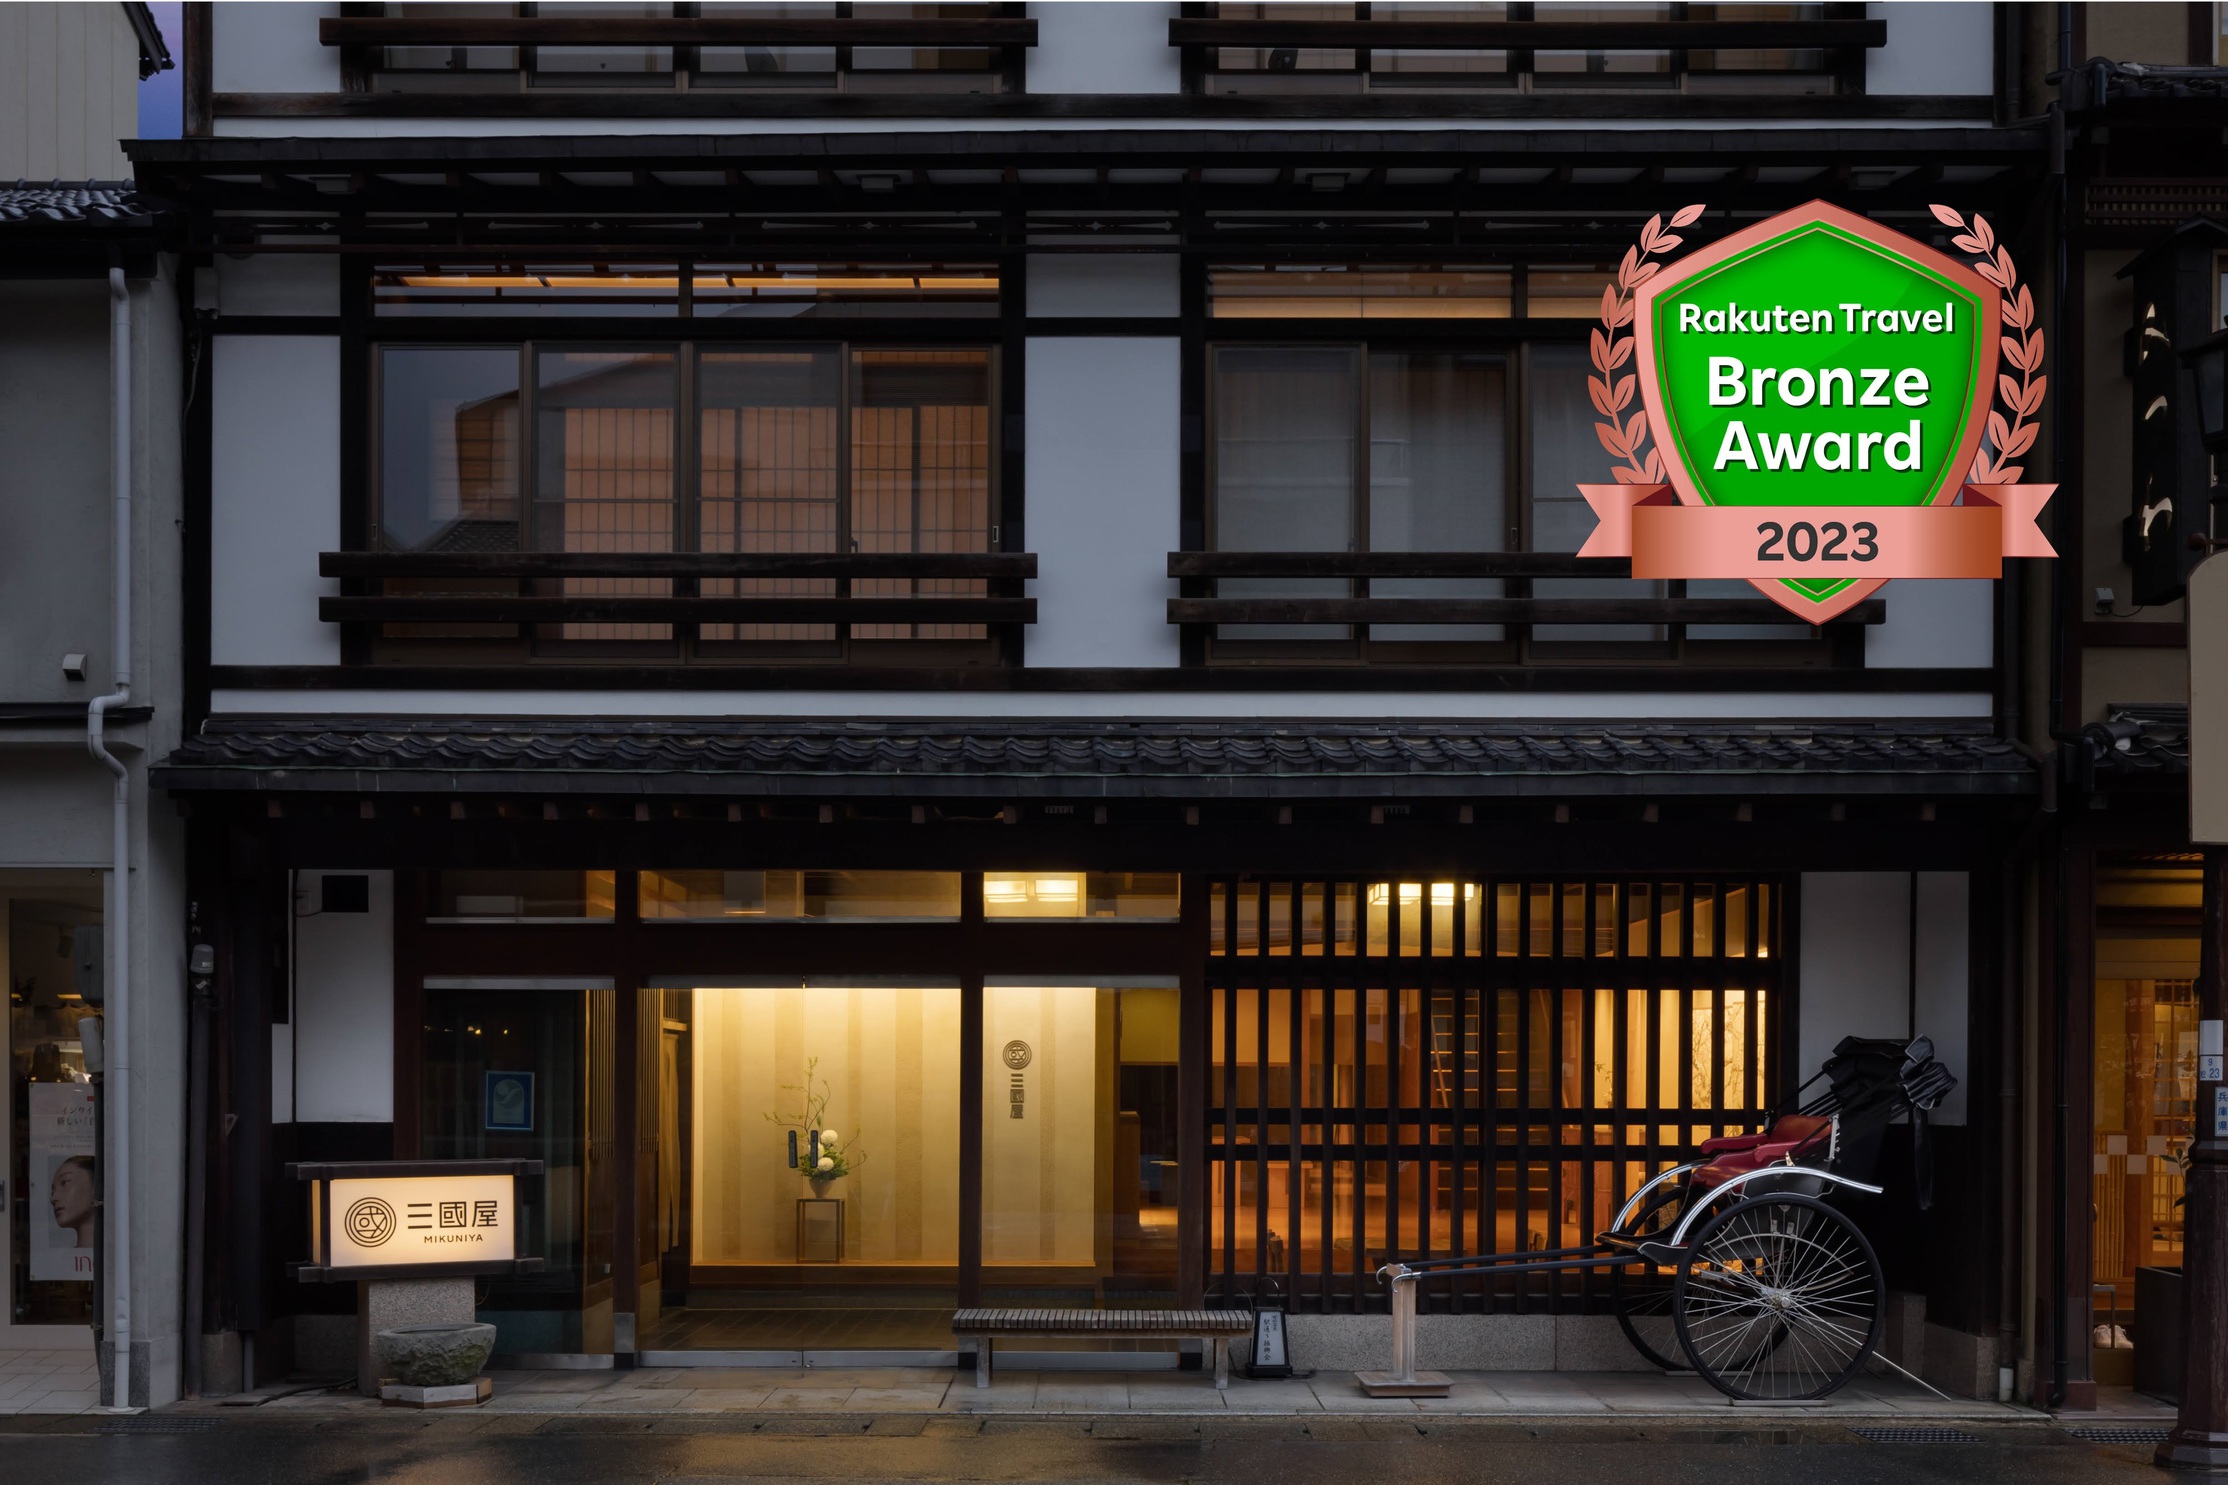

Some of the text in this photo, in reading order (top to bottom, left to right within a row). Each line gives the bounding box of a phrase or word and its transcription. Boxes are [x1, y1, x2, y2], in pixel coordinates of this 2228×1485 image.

[2208, 1058, 2213, 1066] 9
[2209, 1068, 2220, 1079] 23
[407, 1200, 498, 1229] 三國屋
[424, 1234, 483, 1243] MIKUNIYA
